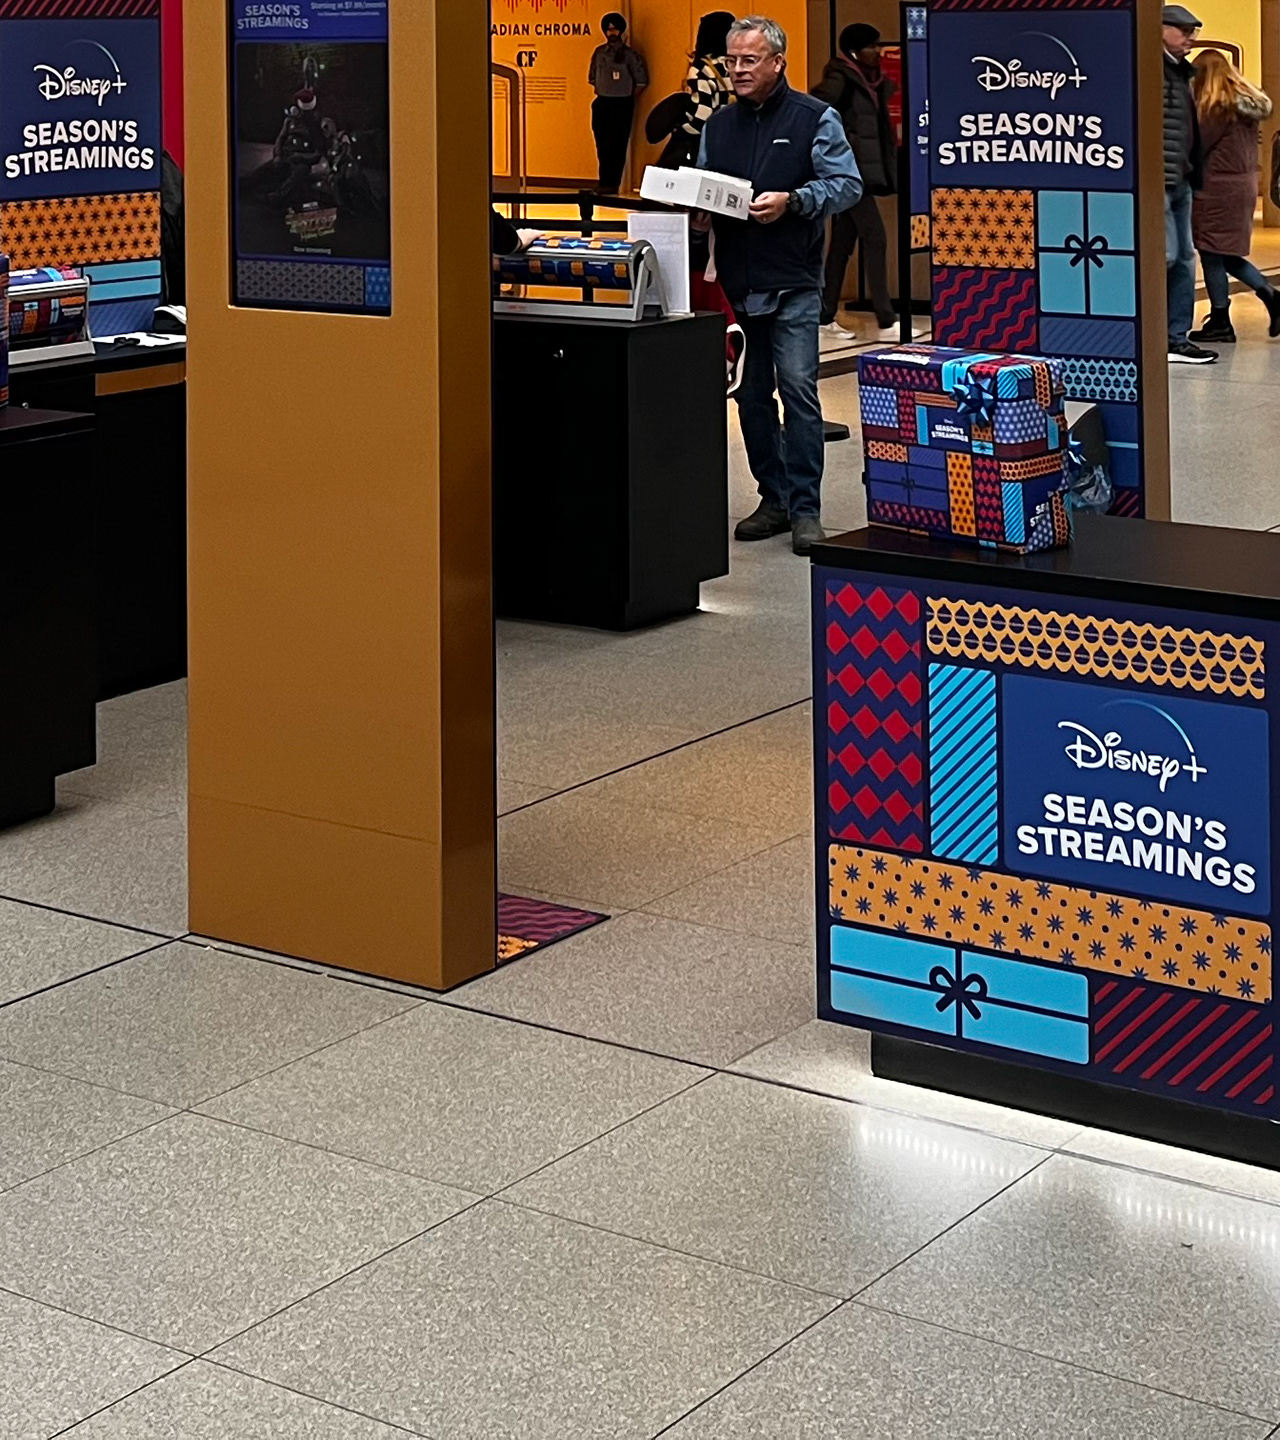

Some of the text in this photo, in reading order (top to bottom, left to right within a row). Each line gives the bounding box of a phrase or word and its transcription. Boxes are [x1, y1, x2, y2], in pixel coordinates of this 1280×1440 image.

[237, 17, 309, 29] STREAMINGS
[245, 4, 300, 17] SEASON'S
[491, 23, 592, 36] ADIAN CHROMA
[516, 50, 538, 67] CF
[33, 65, 127, 106] Disney+
[971, 56, 1087, 100] Disney+
[23, 120, 138, 148] SEASON'S
[959, 113, 1102, 139] SEASON'S
[5, 146, 154, 179] STREAMINGS
[938, 140, 1124, 169] STREAMINGS
[1057, 721, 1208, 791] Disney+
[1042, 794, 1227, 851] SEASON'S
[1017, 825, 1257, 894] STREAMINGS
